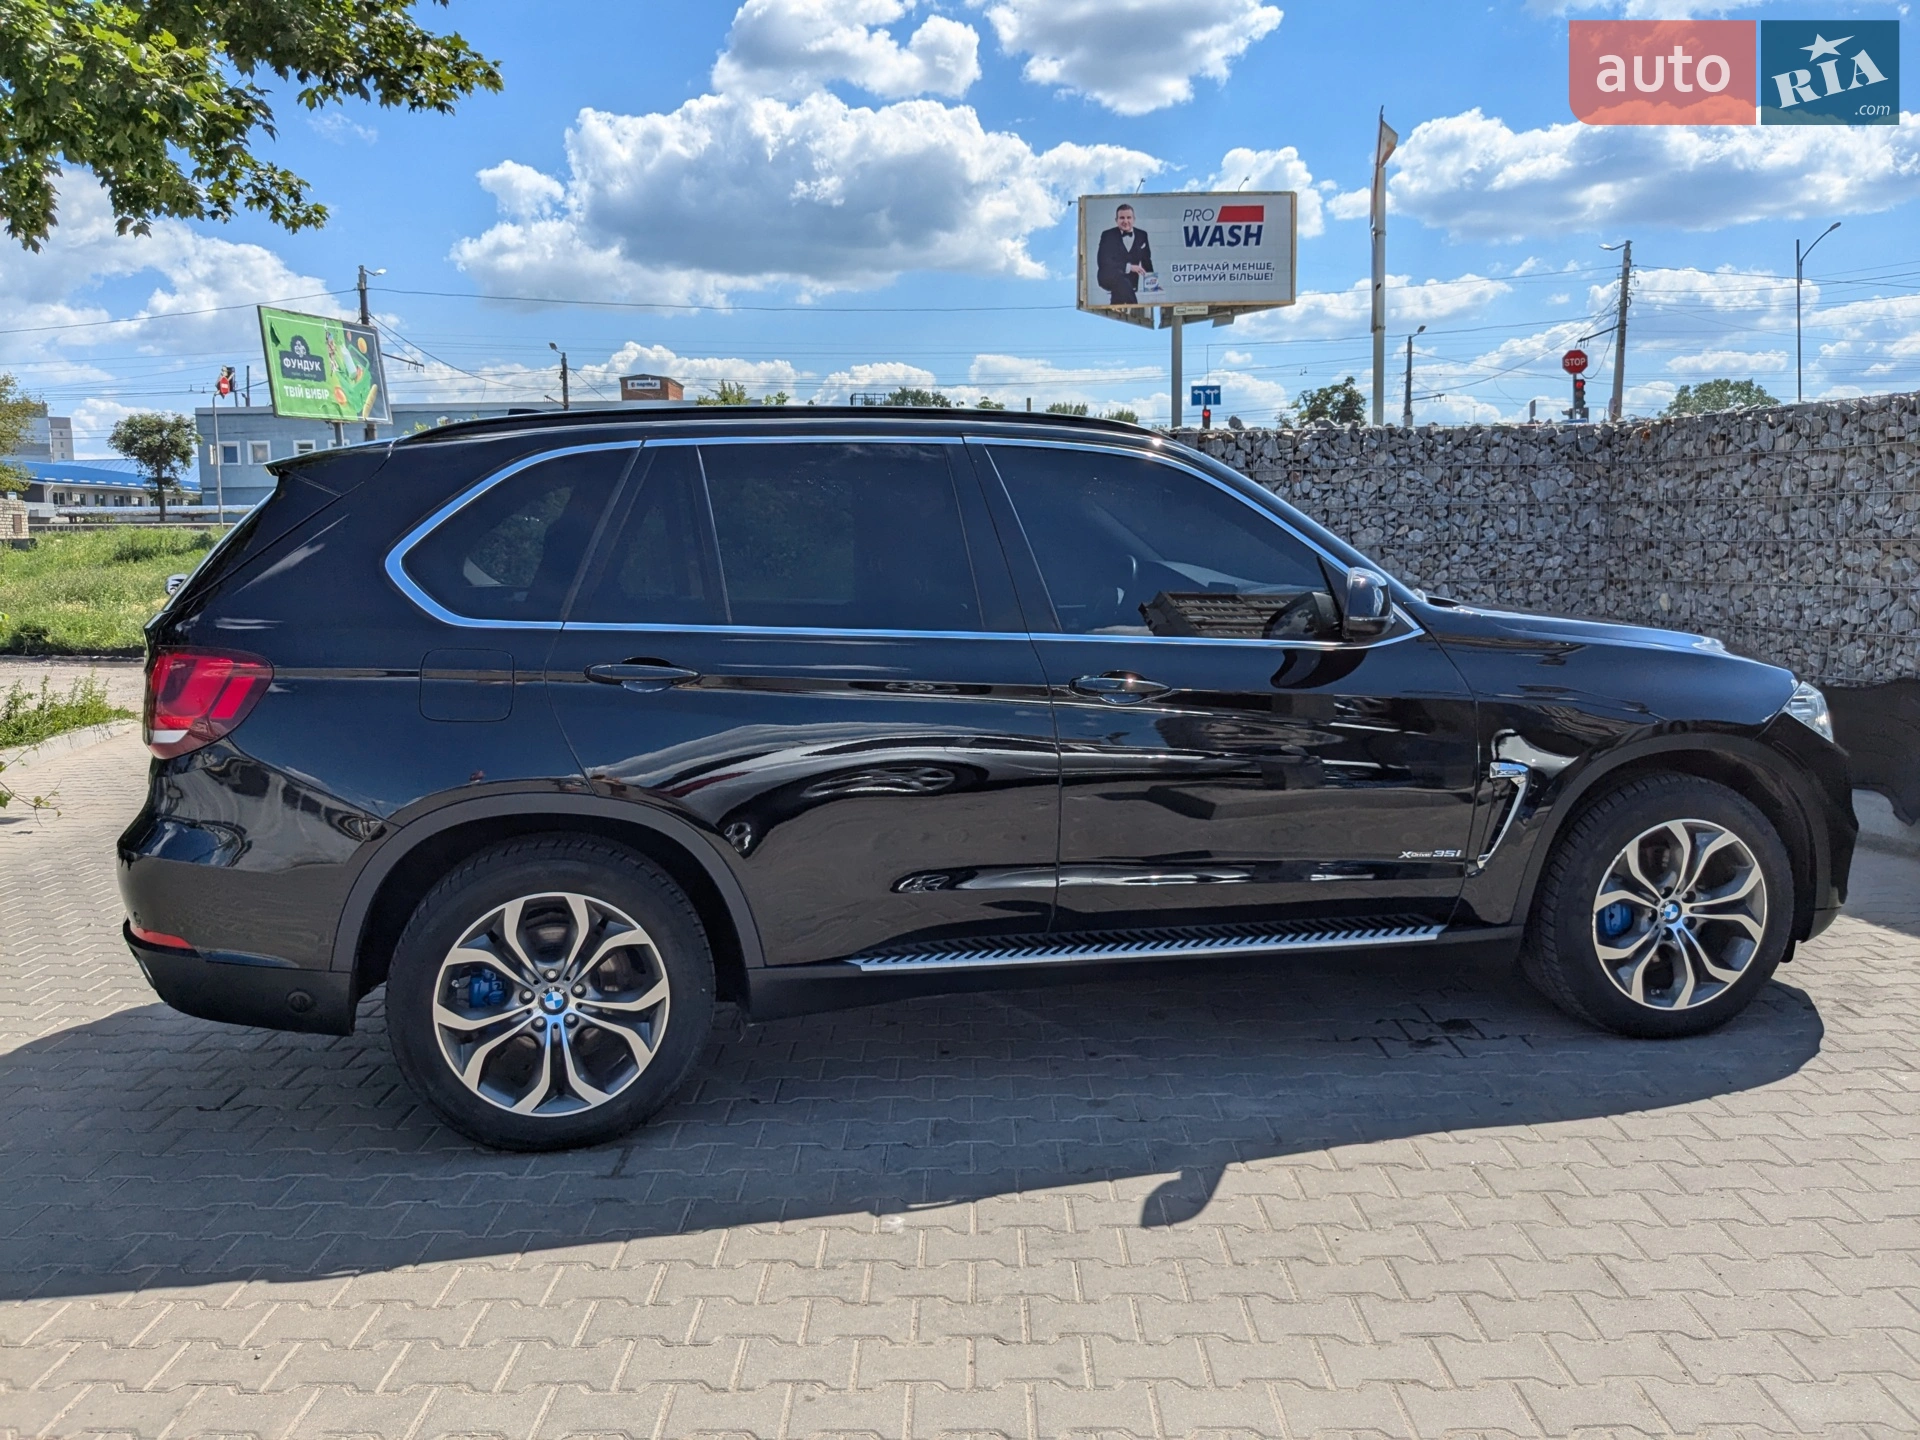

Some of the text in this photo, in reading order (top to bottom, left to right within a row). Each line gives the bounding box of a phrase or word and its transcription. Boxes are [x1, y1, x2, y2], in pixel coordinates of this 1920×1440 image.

[1183, 208, 1215, 222] PRO
[1183, 224, 1264, 248] WASH
[1171, 261, 1275, 272] ВИТРАЧАЙ МЕНШЕ,
[1173, 272, 1274, 282] ОТРИМУЙ БІЛЬШЕ!
[283, 357, 322, 372] ФУНДУК
[1564, 358, 1586, 367] STOP
[283, 383, 330, 400] ТВІЙ ВИБІР
